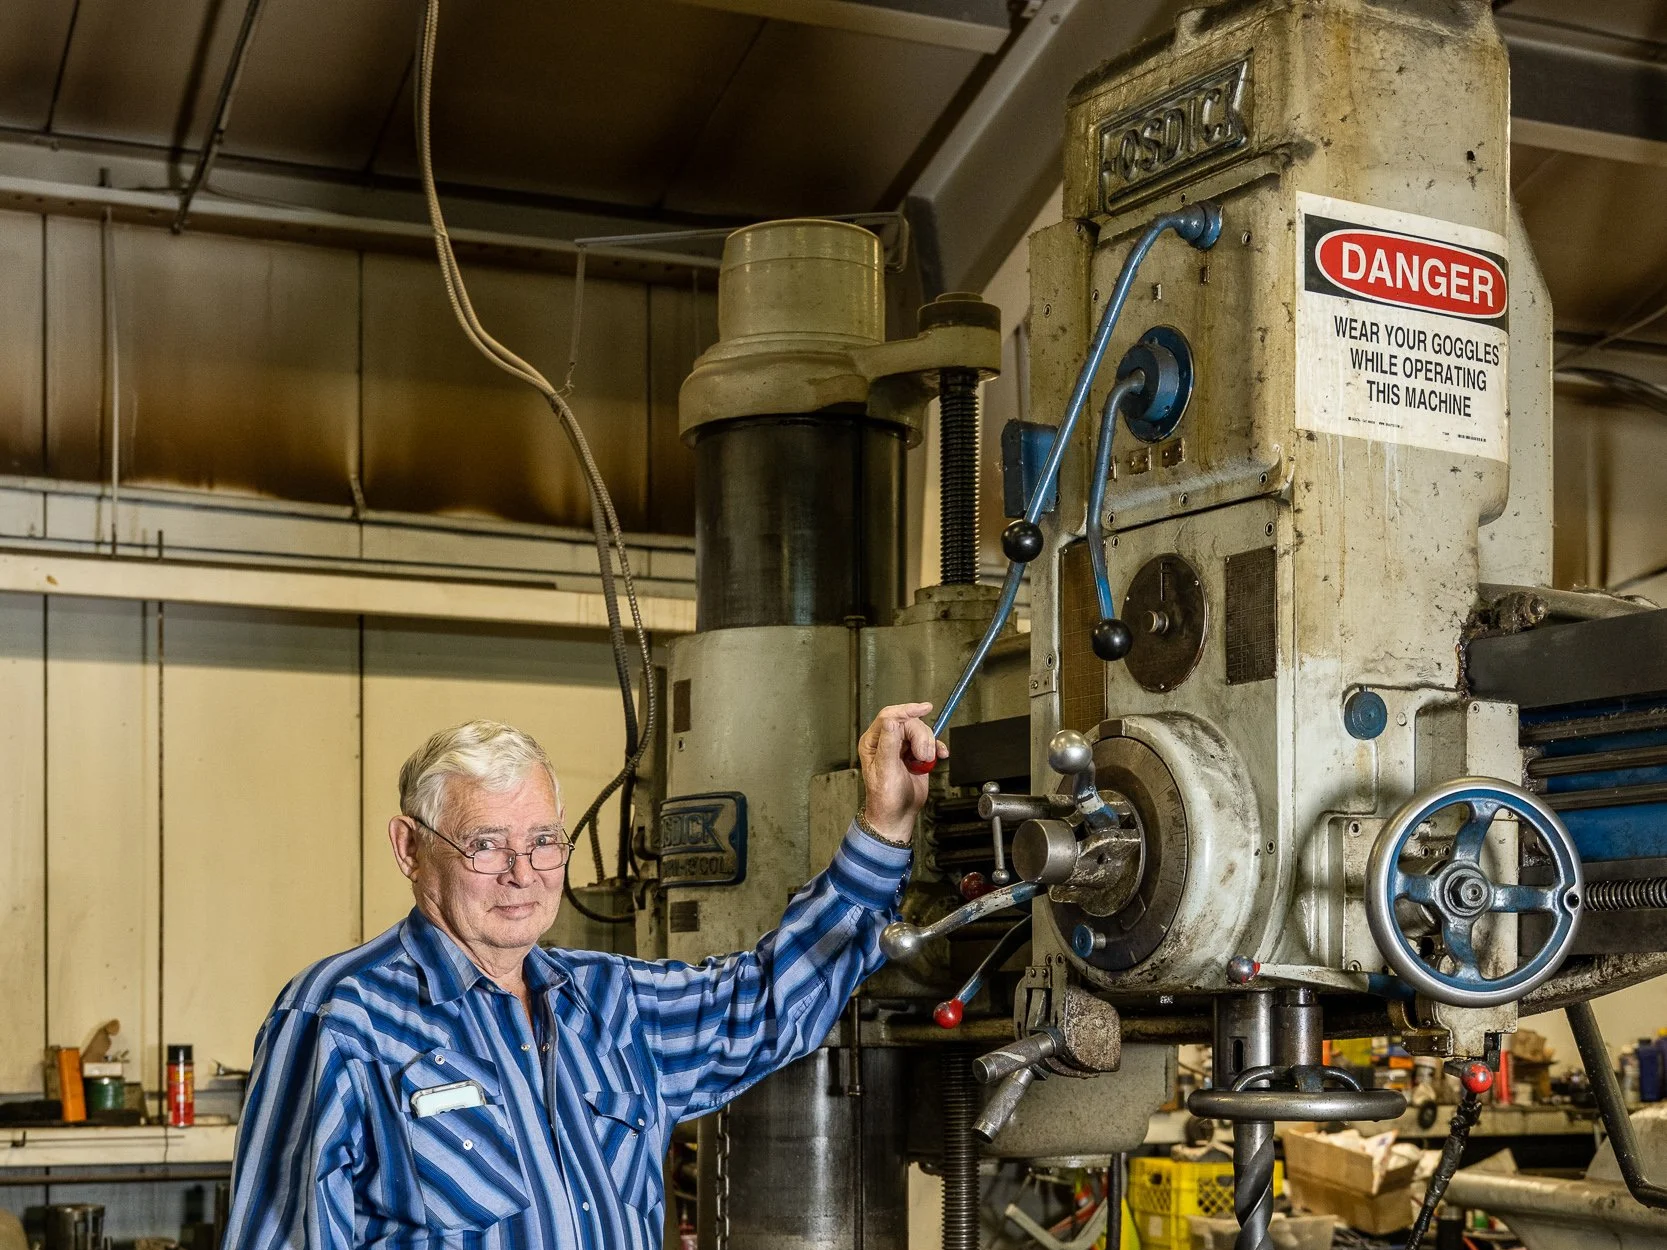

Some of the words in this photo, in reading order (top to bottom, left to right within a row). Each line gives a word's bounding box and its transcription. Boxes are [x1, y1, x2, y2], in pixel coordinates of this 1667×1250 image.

[1342, 241, 1494, 308] DANGER
[1334, 315, 1380, 344] WEAR
[1385, 324, 1427, 352] YOUR
[1431, 333, 1500, 366] GOGGLES
[1350, 347, 1398, 376] WHILE
[1402, 356, 1487, 392] OPERATING
[1366, 379, 1401, 406] THIS
[1405, 386, 1472, 418] MACHINE
